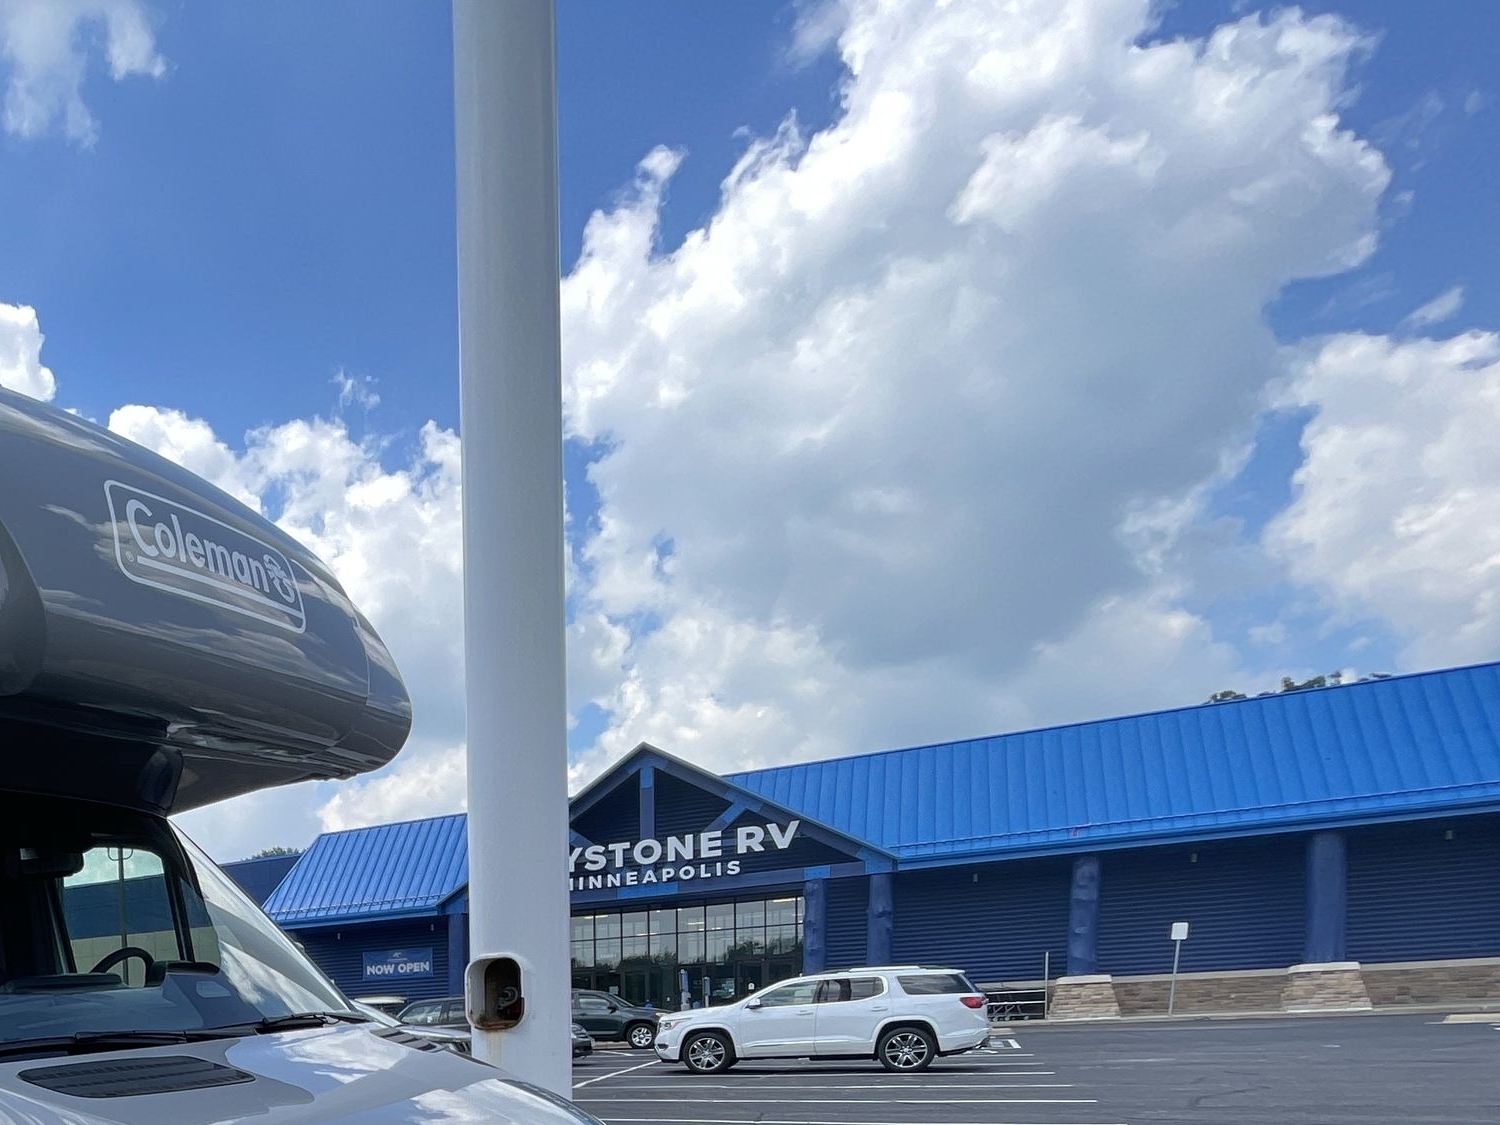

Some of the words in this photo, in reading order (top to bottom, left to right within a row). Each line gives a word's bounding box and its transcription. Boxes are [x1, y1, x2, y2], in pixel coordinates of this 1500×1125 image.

[126, 499, 270, 593] Coleman
[737, 820, 800, 855] RV
[367, 964, 394, 975] NOW
[398, 961, 430, 973] OPEN
